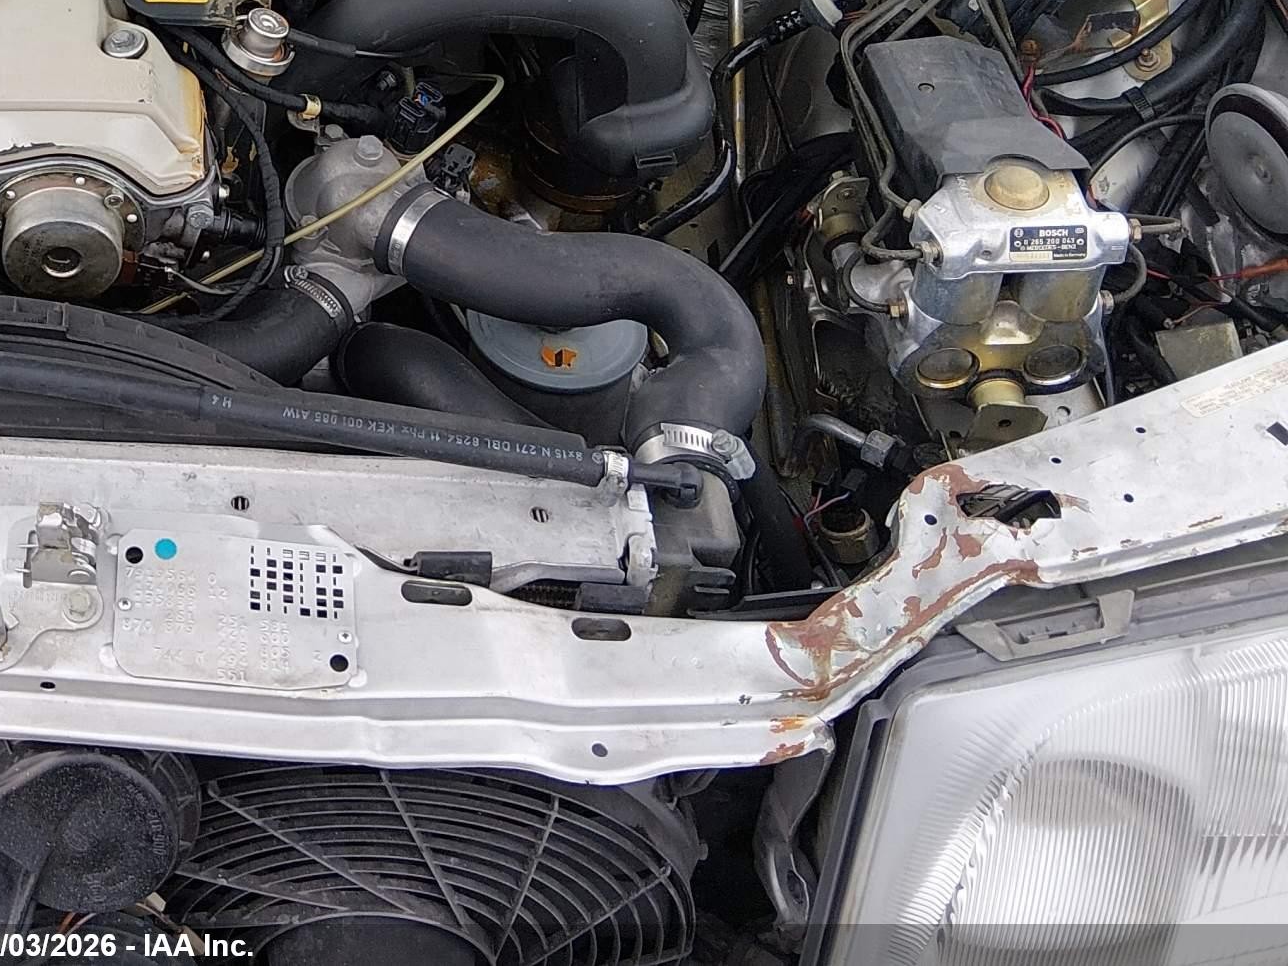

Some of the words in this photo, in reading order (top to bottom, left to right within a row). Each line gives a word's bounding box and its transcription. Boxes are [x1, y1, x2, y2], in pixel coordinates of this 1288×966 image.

[1038, 228, 1069, 238] BOSCH
[342, 414, 363, 429] 001
[367, 420, 396, 435] KEK
[484, 437, 511, 452] DBL
[515, 444, 538, 457] 271
[541, 446, 552, 458] N
[554, 449, 584, 462] 8x15
